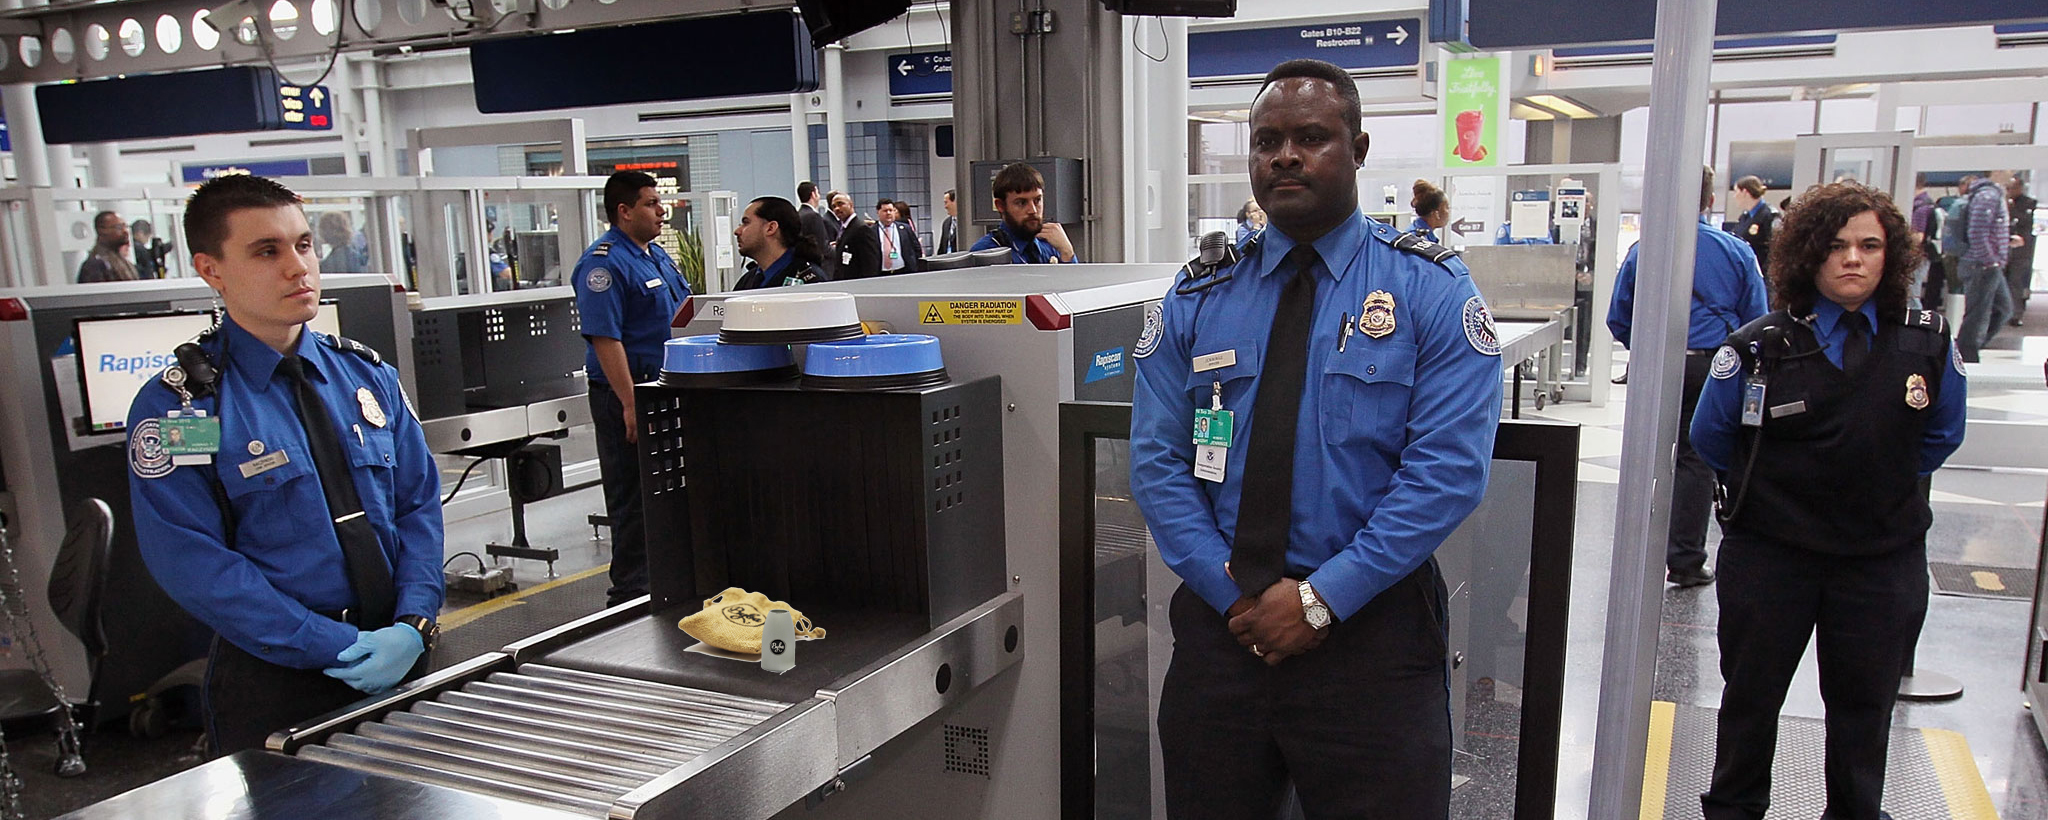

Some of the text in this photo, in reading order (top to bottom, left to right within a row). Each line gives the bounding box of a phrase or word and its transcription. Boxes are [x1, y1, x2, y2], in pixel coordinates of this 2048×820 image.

[1301, 27, 1361, 38] Gates B10-B22
[1316, 39, 1361, 47] Restrooms
[979, 301, 1017, 309] RADIATION
[1920, 309, 1932, 325] TSA
[1095, 352, 1121, 366] Rapiscan
